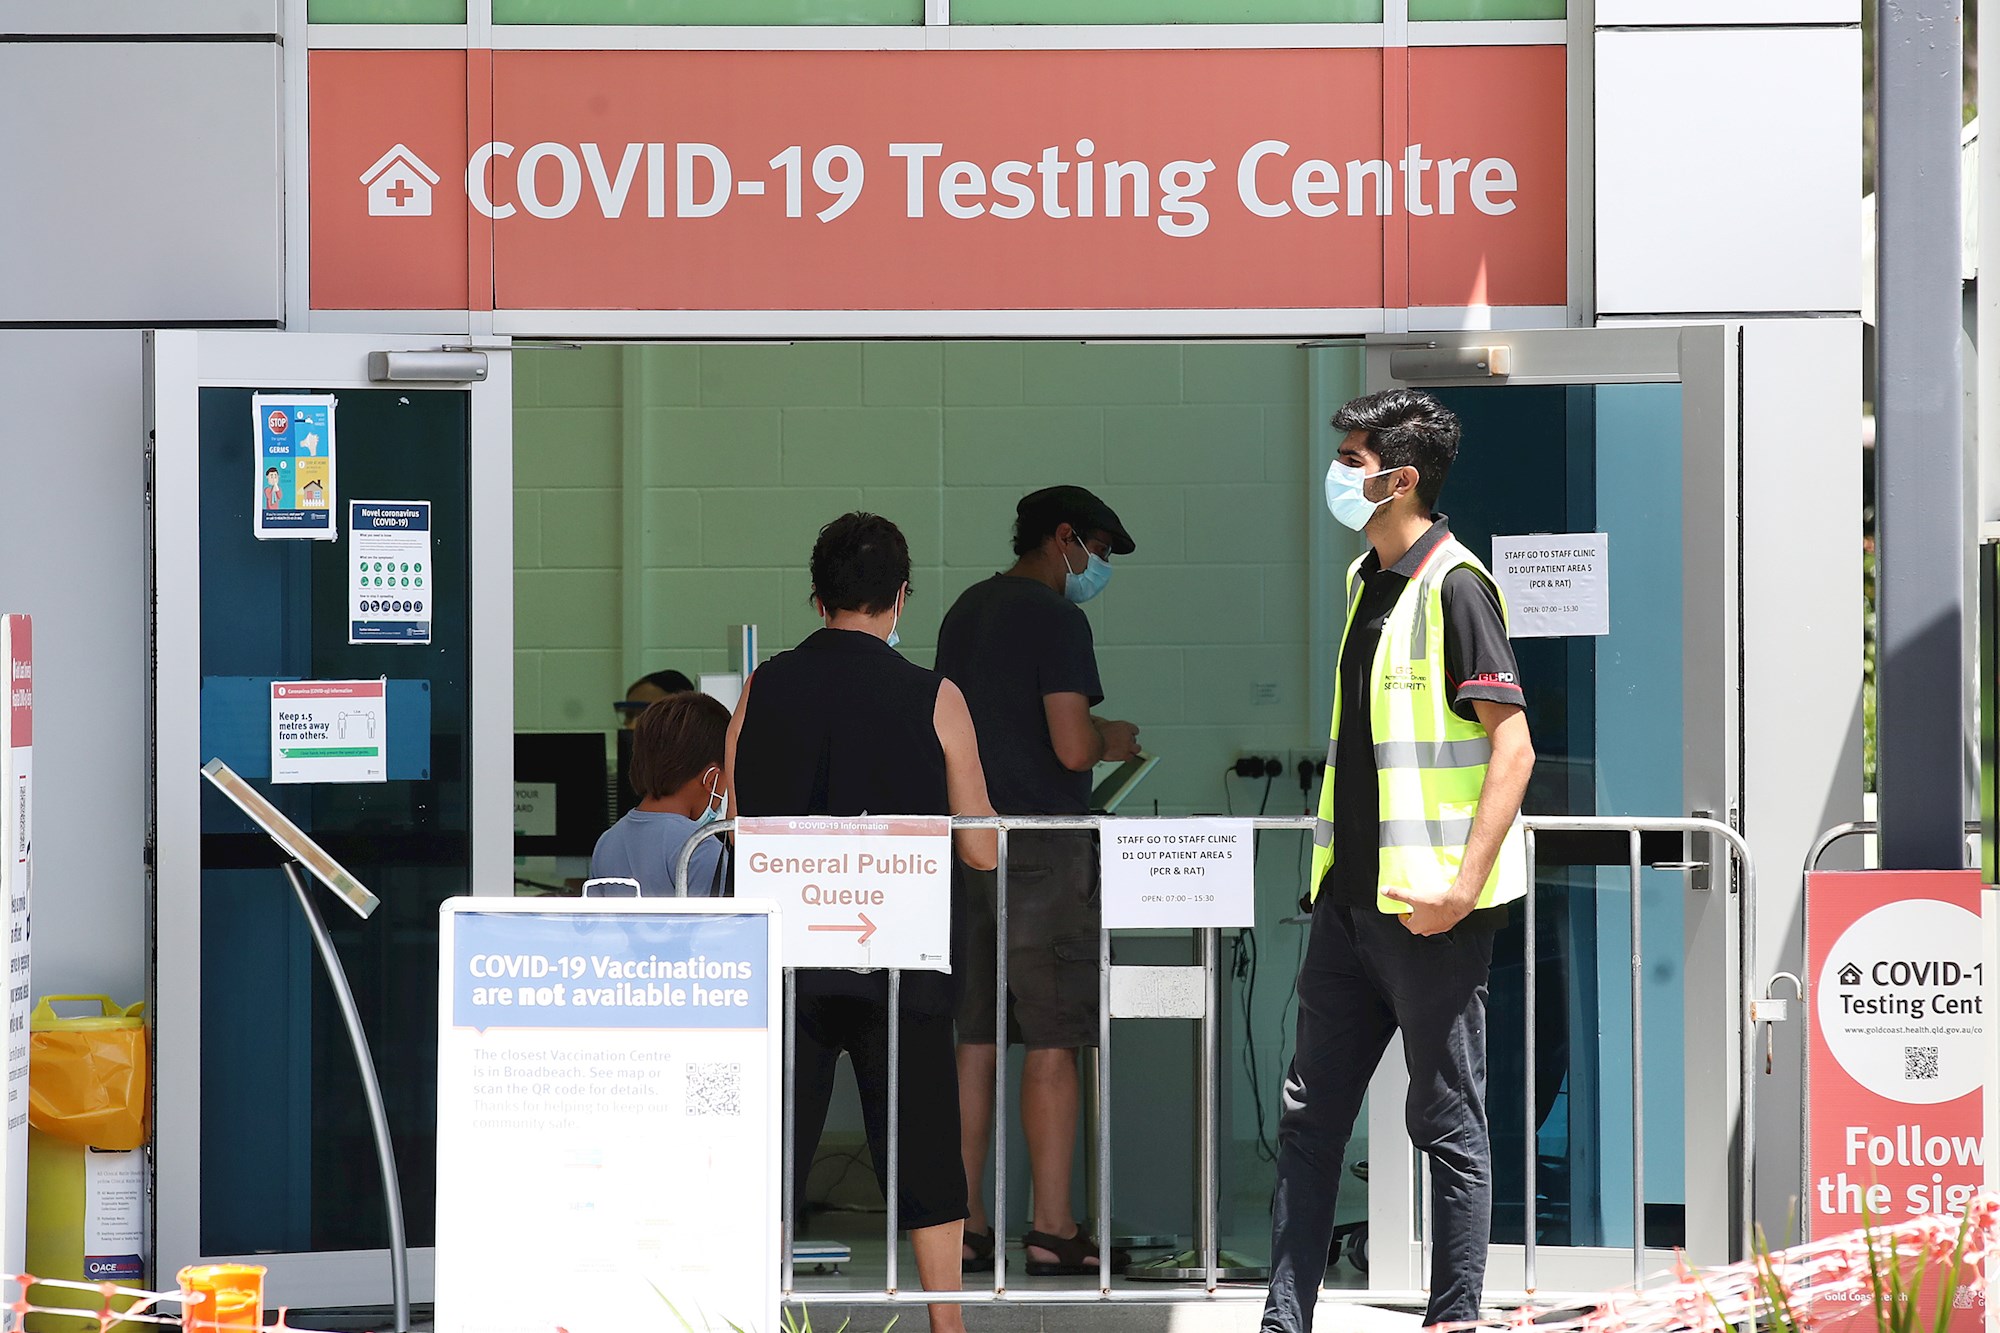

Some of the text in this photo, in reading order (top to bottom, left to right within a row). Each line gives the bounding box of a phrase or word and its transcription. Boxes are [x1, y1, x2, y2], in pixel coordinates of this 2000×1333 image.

[465, 137, 1519, 238] COVID-19 Testing Centre
[270, 418, 286, 428] STOP
[362, 509, 420, 518] Novel coronavirus
[373, 518, 409, 527] (COVID-19)
[1537, 565, 1565, 573] PATIENT
[1530, 580, 1546, 589] (PCR
[1555, 579, 1571, 588] RAT)
[1479, 673, 1513, 682] GCPD
[279, 712, 299, 722] Keep
[309, 723, 329, 732] away
[279, 732, 328, 740] from others.
[516, 790, 539, 798] YOUR
[798, 822, 889, 831] COVID-19 Information
[1117, 835, 1237, 844] STAFF GO TO STAFF CLINIC
[1122, 851, 1134, 860] D1
[1137, 851, 1157, 860] OUT
[1159, 851, 1197, 859] PATIENT
[1200, 851, 1224, 859] AREA
[749, 852, 938, 874] General Public
[1150, 866, 1205, 876] (PCR & RAT)
[801, 884, 885, 906] Queue
[469, 954, 752, 980] COVID-19 Vaccinations
[472, 982, 750, 1007] are not available here
[1840, 994, 1925, 1019] Testing
[1845, 1026, 1983, 1035] www.goldcoast.health.qld.gov.au/co
[474, 1048, 672, 1062] The closest Vaccination Centre
[473, 1066, 661, 1080] is in Broadbeach. See map or
[473, 1083, 659, 1096] scan the QR code for details.
[473, 1099, 670, 1115] Thanks for helping to keep our
[472, 1118, 545, 1131] community
[1846, 1124, 1984, 1166] Follow
[1817, 1173, 1984, 1218] the sig
[1825, 1292, 1846, 1301] Gold
